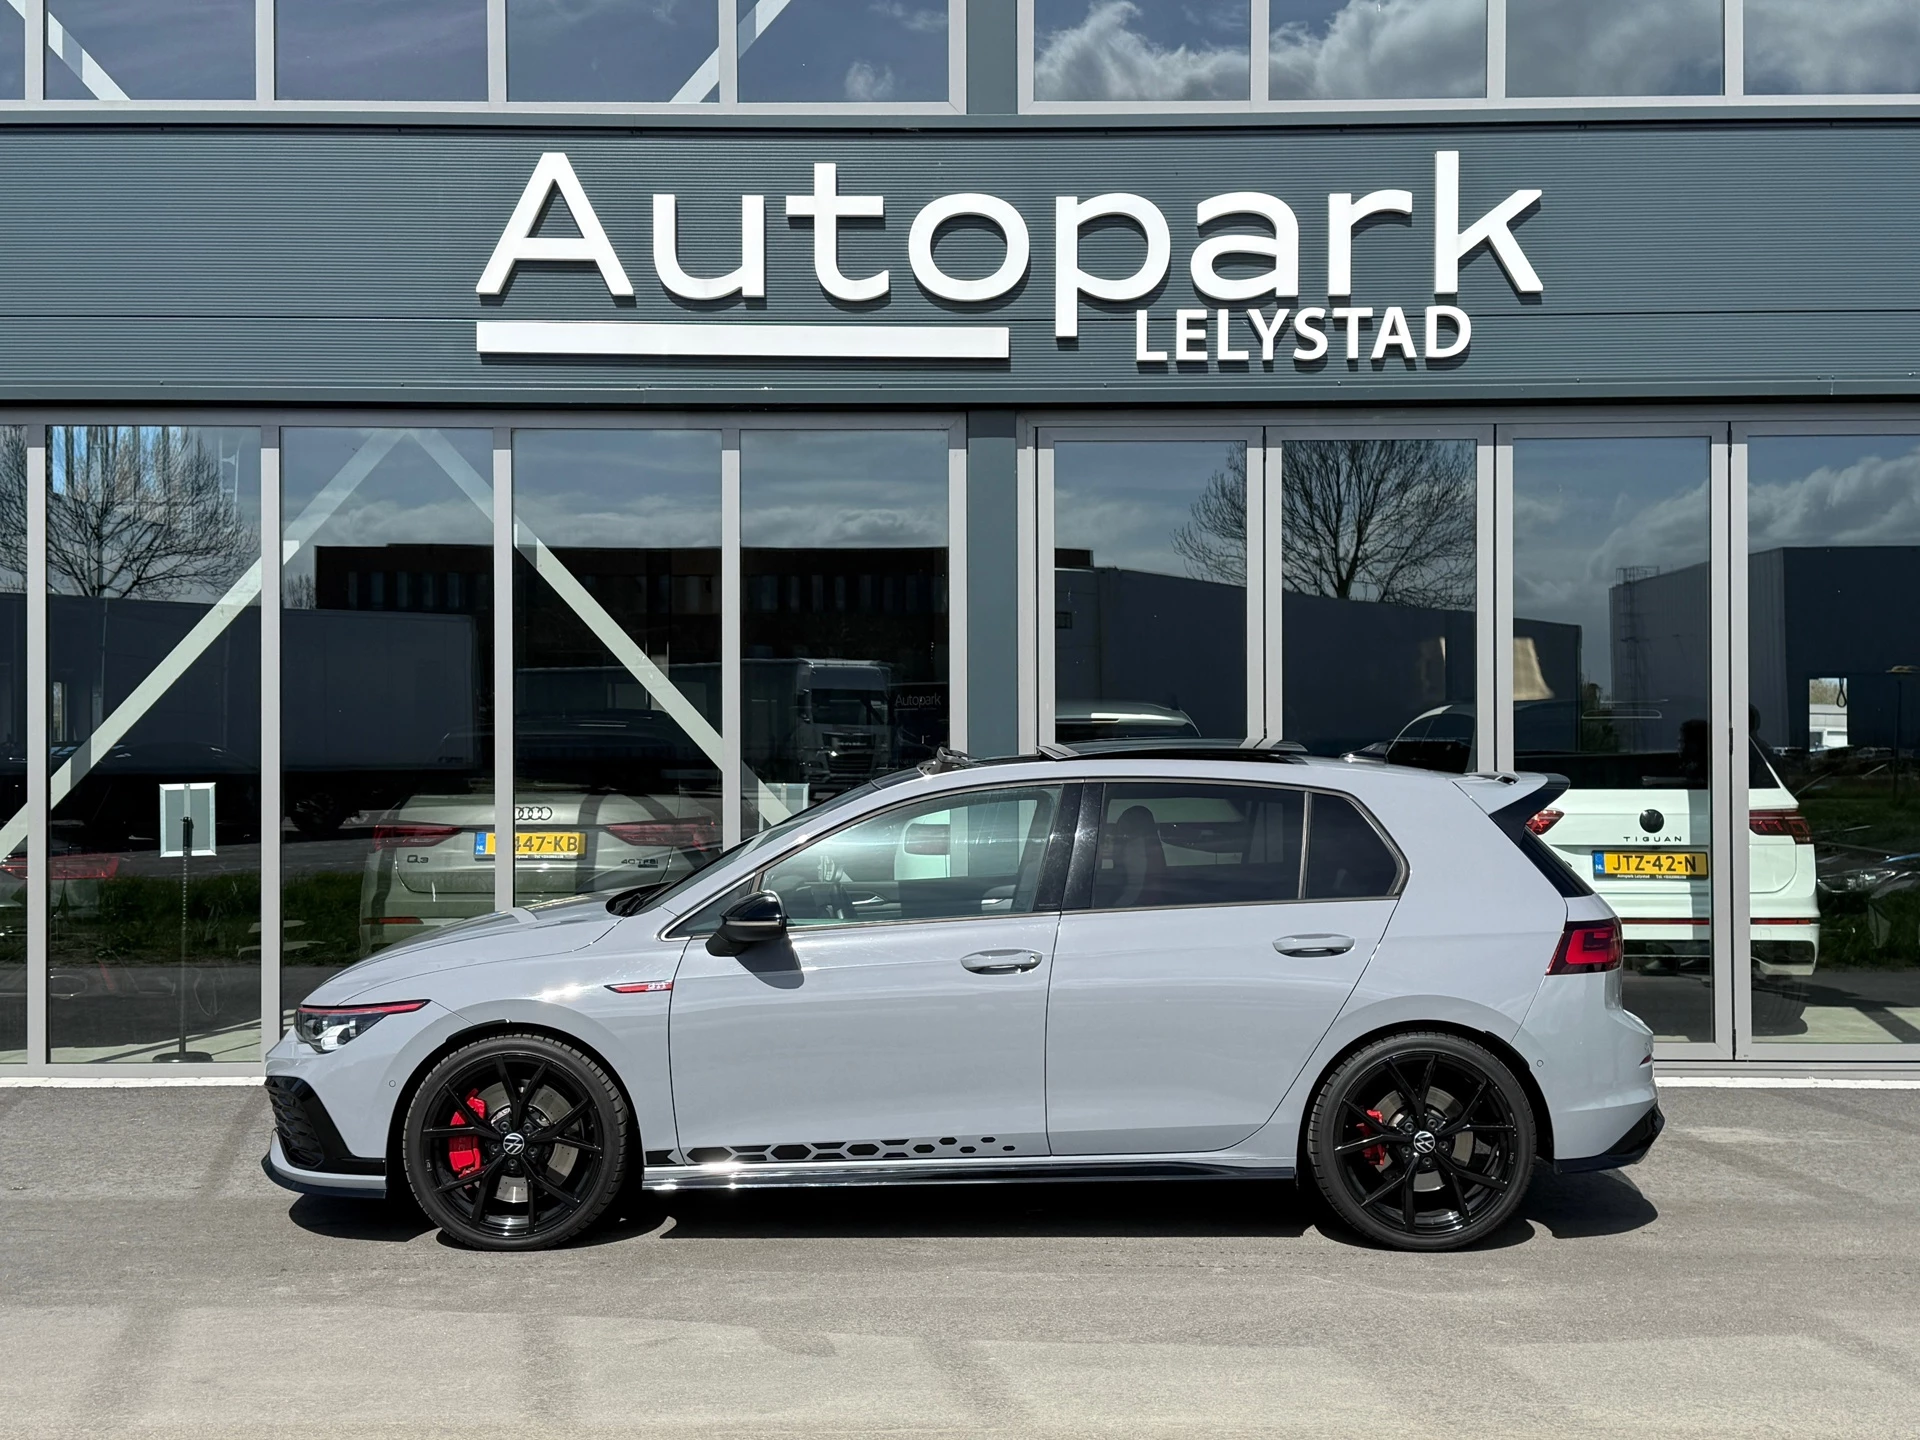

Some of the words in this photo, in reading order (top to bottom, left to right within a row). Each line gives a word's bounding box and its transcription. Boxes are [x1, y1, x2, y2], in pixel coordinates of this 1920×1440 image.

[476, 151, 1543, 337] Autopark
[1136, 306, 1472, 361] LELYSTAD
[493, 835, 578, 852] 447-KB
[407, 855, 429, 863] Q3
[1612, 855, 1697, 872] JTZ-42-N
